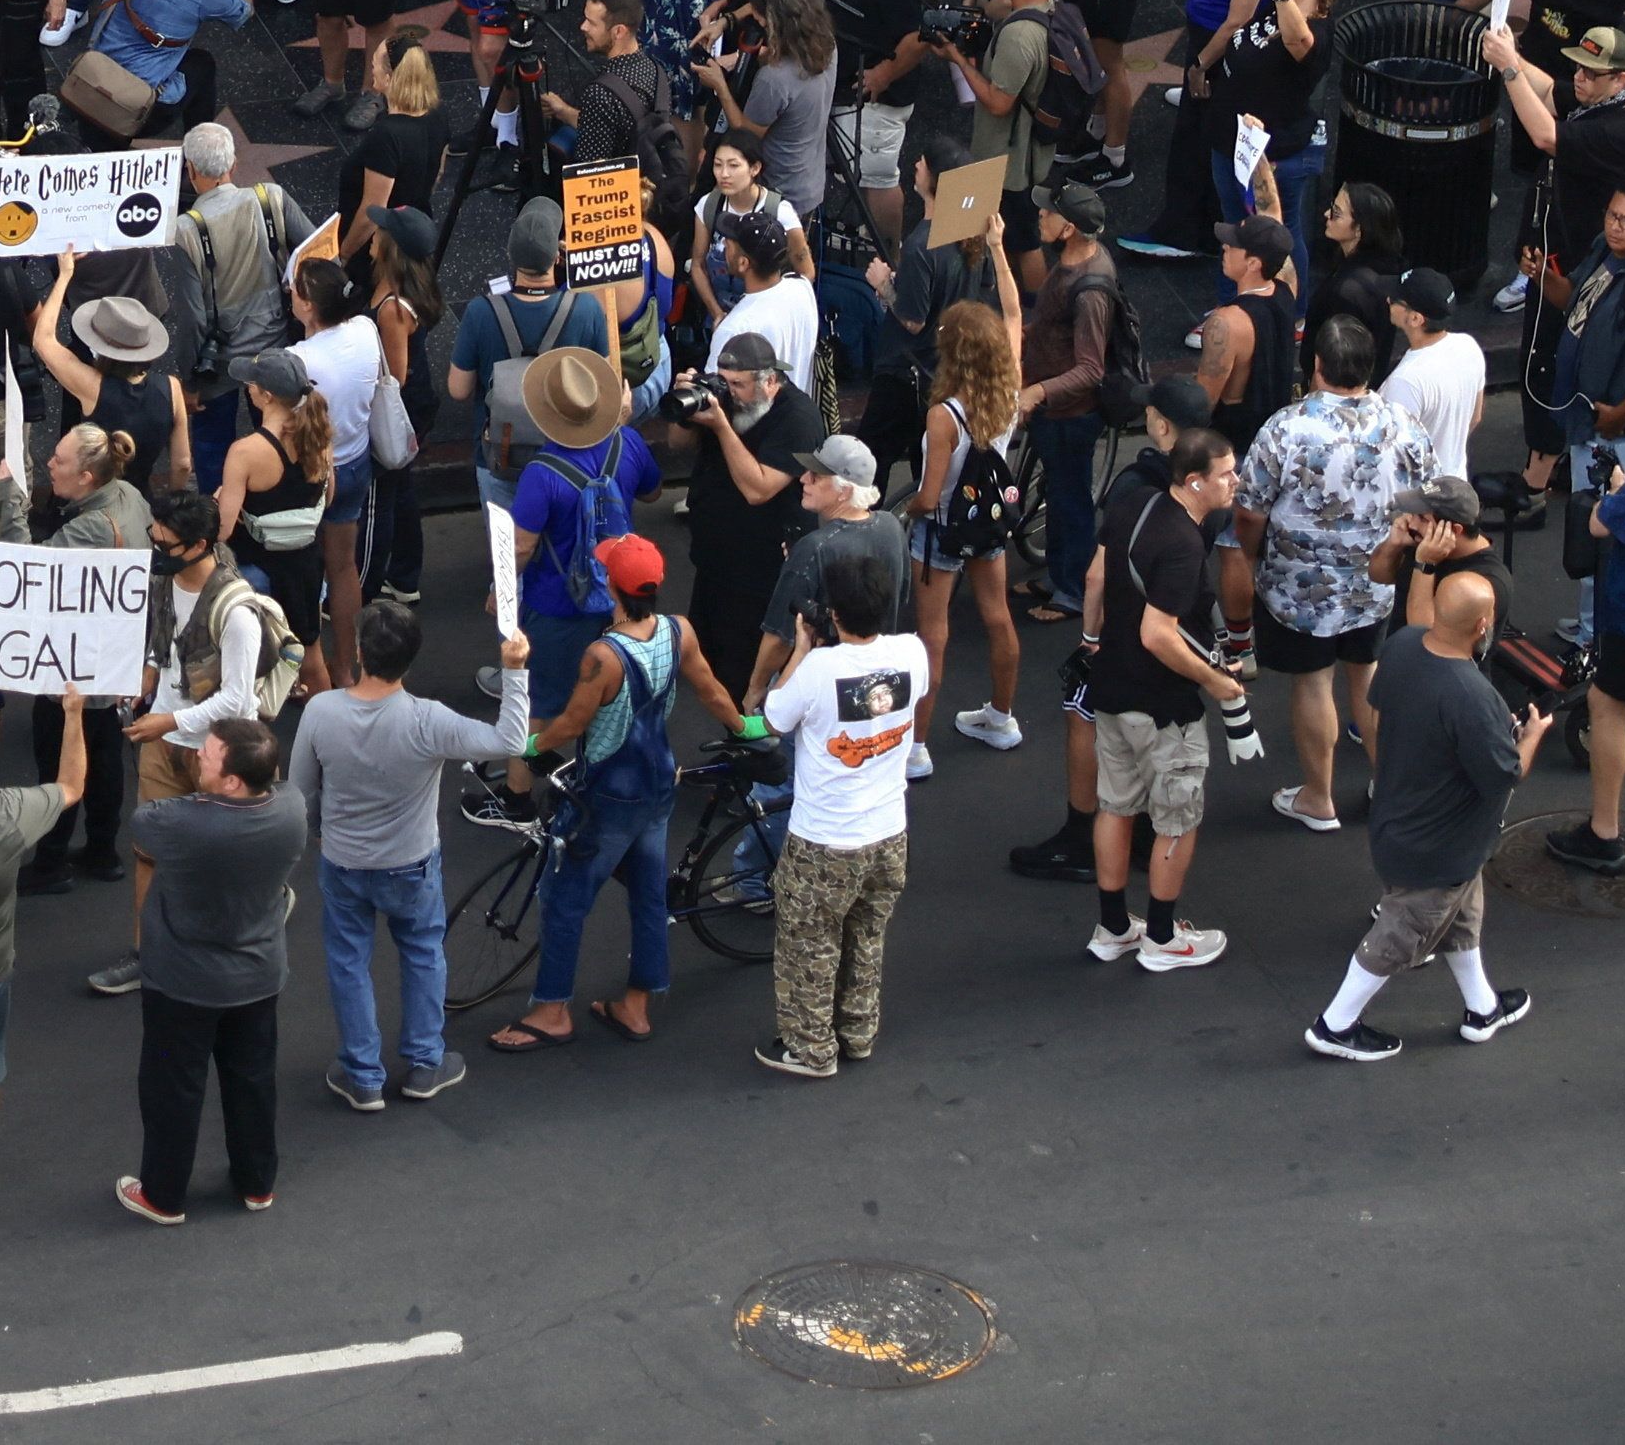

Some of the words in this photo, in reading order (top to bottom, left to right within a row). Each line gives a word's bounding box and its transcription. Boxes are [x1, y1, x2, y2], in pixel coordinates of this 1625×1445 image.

[38, 164, 99, 201] Comes
[588, 178, 615, 188] The
[76, 201, 116, 212] comedy
[576, 190, 629, 207] Trump
[65, 214, 87, 223] from
[118, 205, 159, 223] abc
[571, 204, 635, 226] Fascist
[571, 224, 637, 244] Regime
[570, 248, 614, 265] MUST
[618, 243, 640, 256] GO
[575, 258, 638, 281] NOW!!!
